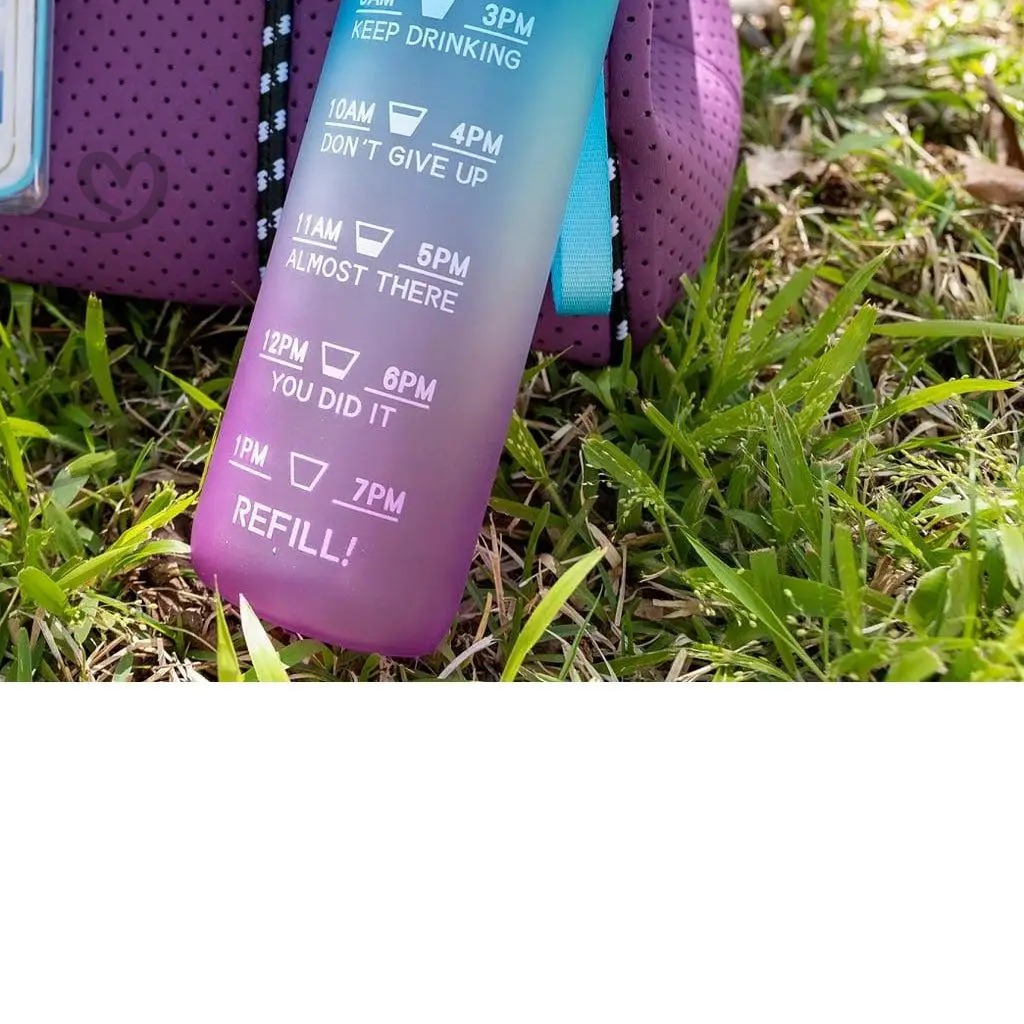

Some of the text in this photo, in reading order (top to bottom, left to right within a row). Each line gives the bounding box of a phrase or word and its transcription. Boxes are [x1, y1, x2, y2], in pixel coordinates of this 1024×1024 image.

[482, 3, 535, 37] 3PM
[351, 20, 522, 70] KEEP DRINKING
[328, 98, 376, 124] 10AM
[450, 122, 504, 156] 4PM
[321, 132, 488, 187] DON'T GIVE UP
[295, 213, 343, 243] 11AM
[416, 242, 471, 278] 5PM
[285, 249, 459, 314] ALMOST THERE
[263, 329, 309, 363] 12PM
[272, 371, 397, 427] YOU DID IT
[382, 366, 437, 402] 6PM
[234, 434, 268, 468] 1PM
[352, 477, 406, 514] 7PM
[232, 494, 358, 567] REFILL!
